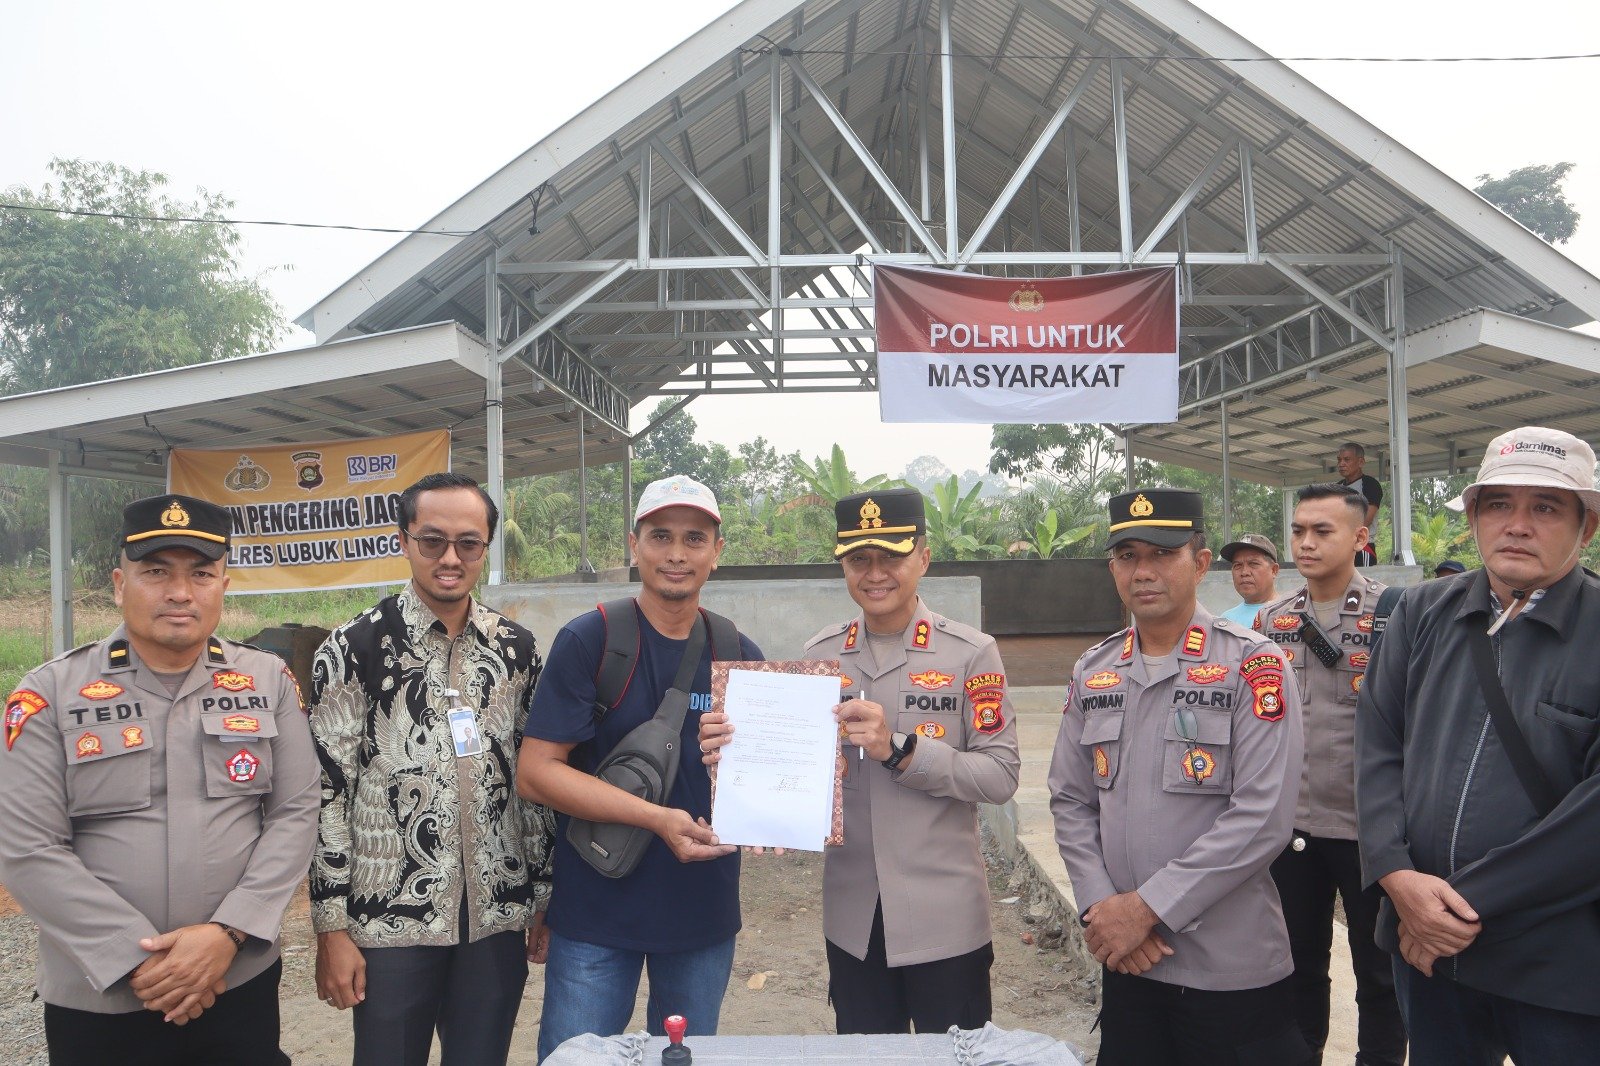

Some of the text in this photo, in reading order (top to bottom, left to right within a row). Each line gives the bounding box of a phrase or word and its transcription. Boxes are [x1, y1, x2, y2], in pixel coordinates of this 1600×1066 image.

[929, 324, 1126, 348] POLRI UNTUK
[928, 364, 1126, 388] MASYARAKAT
[368, 454, 396, 473] BRI
[246, 498, 360, 534] PENGERING
[278, 540, 339, 561] LUBUK
[344, 535, 401, 558] LINGG
[1268, 632, 1304, 643] FERD
[203, 697, 268, 711] POLRI
[688, 693, 712, 711] DIB
[905, 695, 957, 711] POLRI
[1173, 690, 1231, 708] POLRI
[69, 702, 143, 725] TEDI
